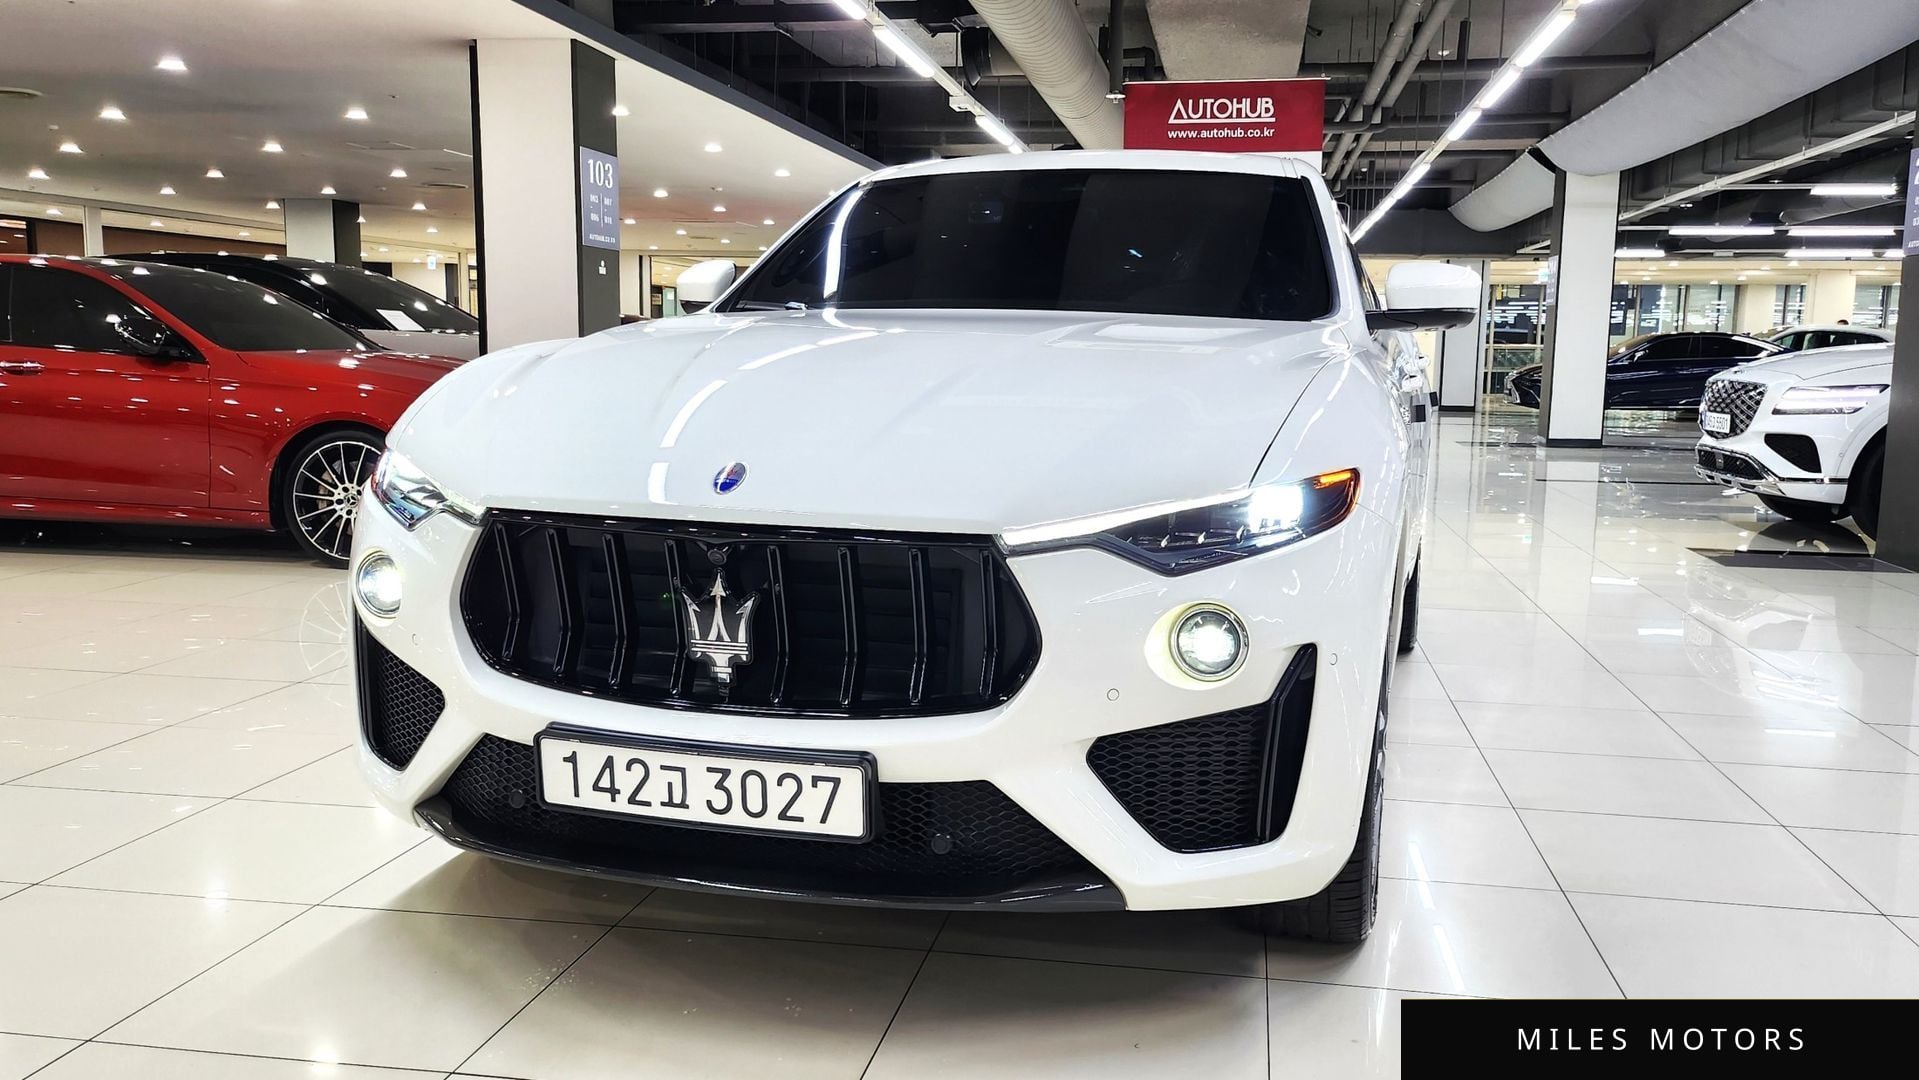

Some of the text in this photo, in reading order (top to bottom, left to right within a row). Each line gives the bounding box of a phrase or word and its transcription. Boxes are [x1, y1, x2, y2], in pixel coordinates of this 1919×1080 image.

[1168, 98, 1276, 124] AUTOHUB
[1168, 127, 1275, 139] www.autohub.co.kr
[588, 159, 613, 189] 103
[562, 751, 842, 824] 142고 3027
